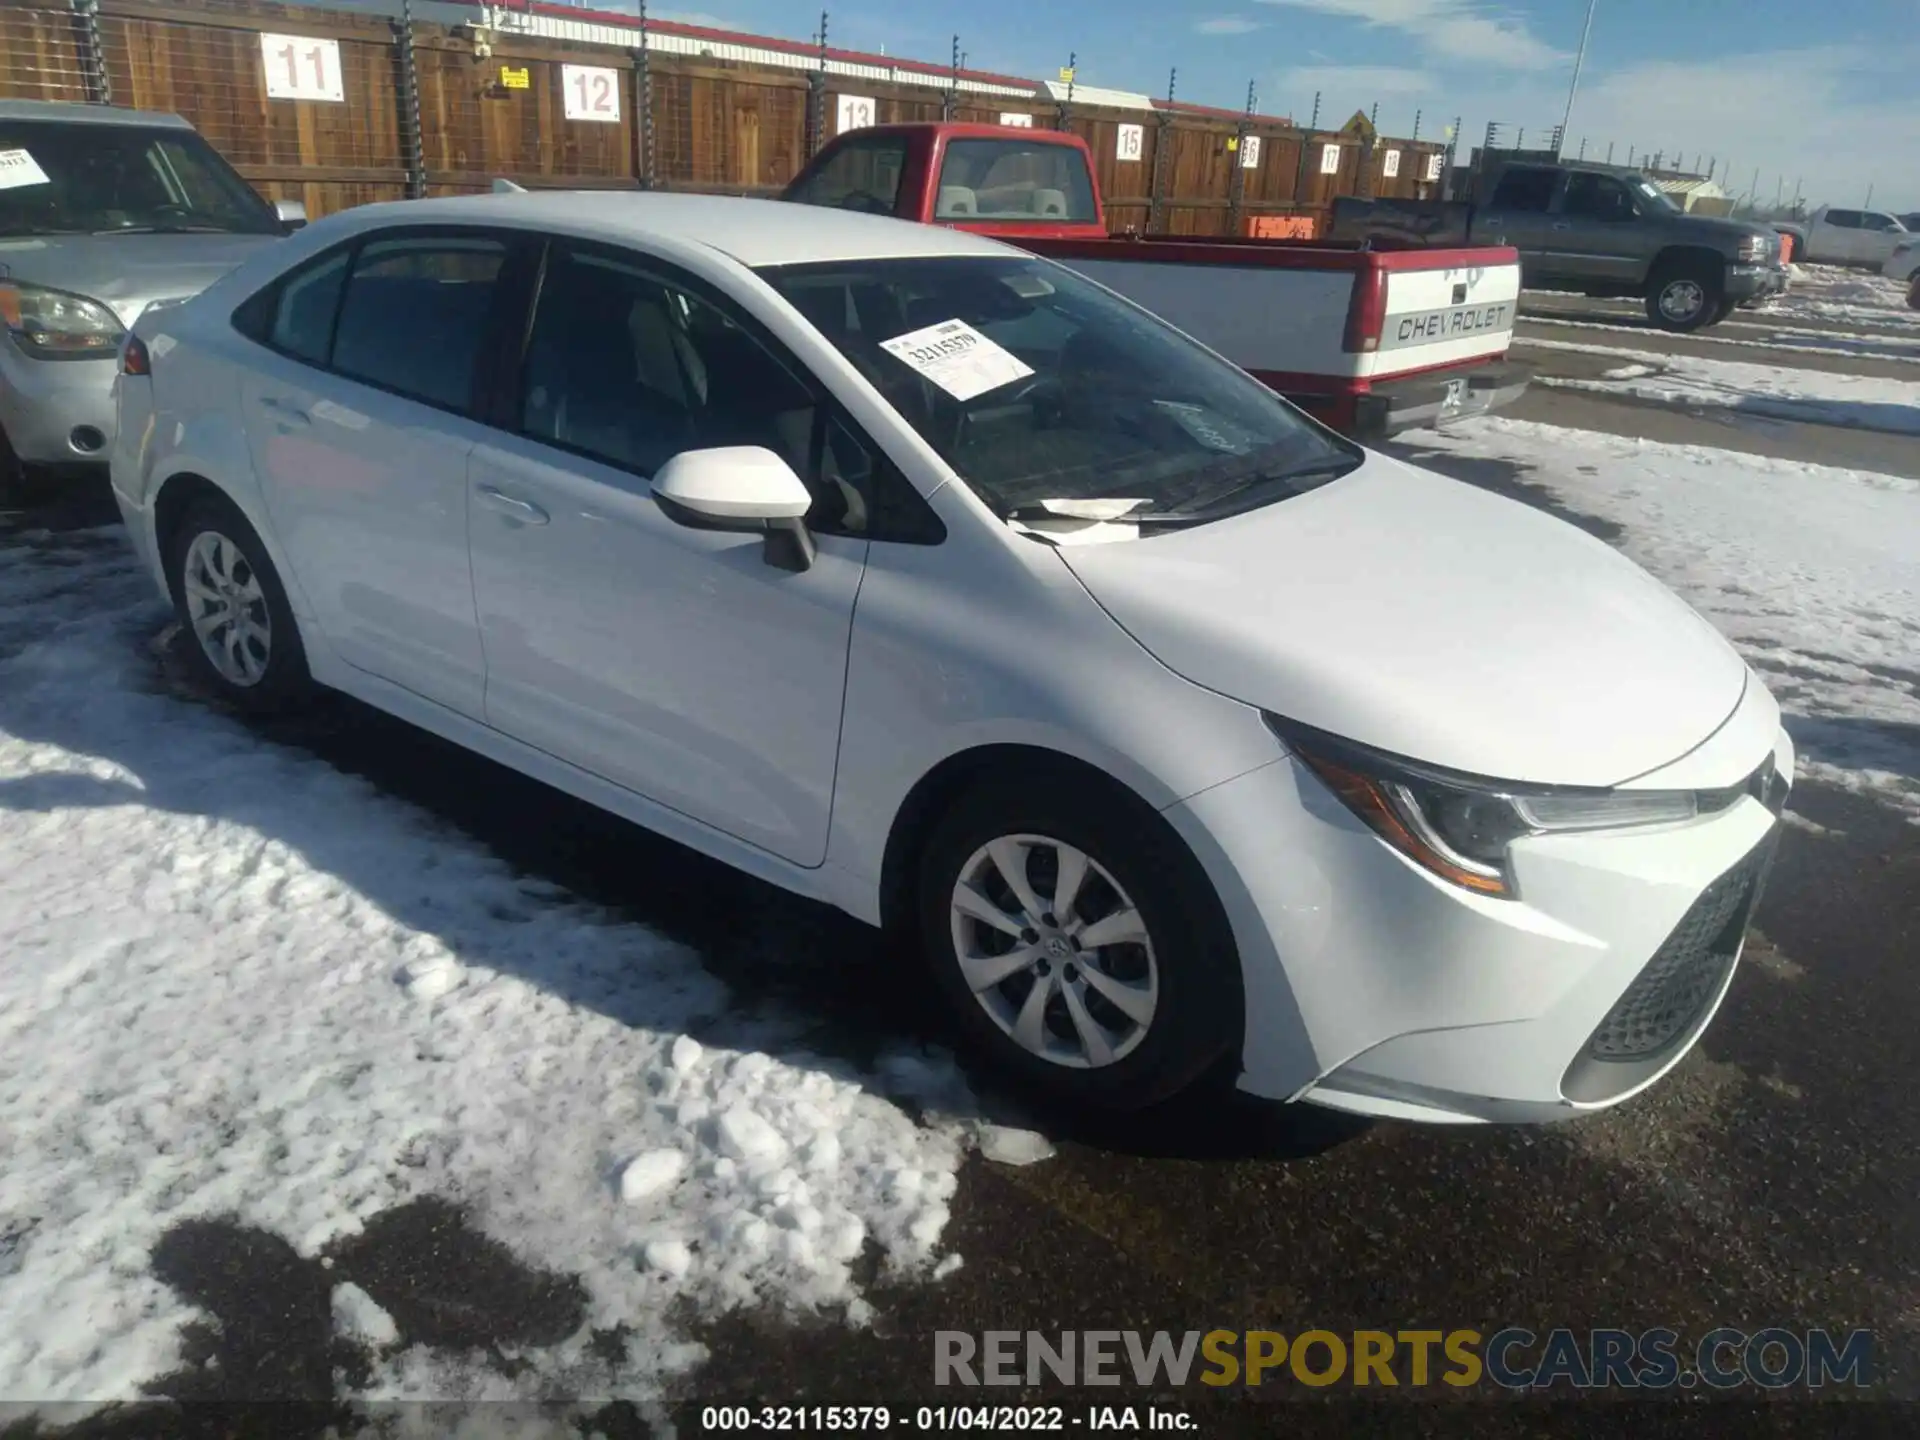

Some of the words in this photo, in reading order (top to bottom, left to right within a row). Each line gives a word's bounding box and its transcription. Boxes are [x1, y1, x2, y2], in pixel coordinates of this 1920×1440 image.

[277, 44, 325, 90] 11
[573, 73, 611, 112] 12
[845, 102, 869, 129] 13
[1121, 129, 1139, 155] 15
[1326, 147, 1337, 169] 17
[1398, 306, 1505, 341] CHEVROLET
[908, 333, 977, 364] 32115379
